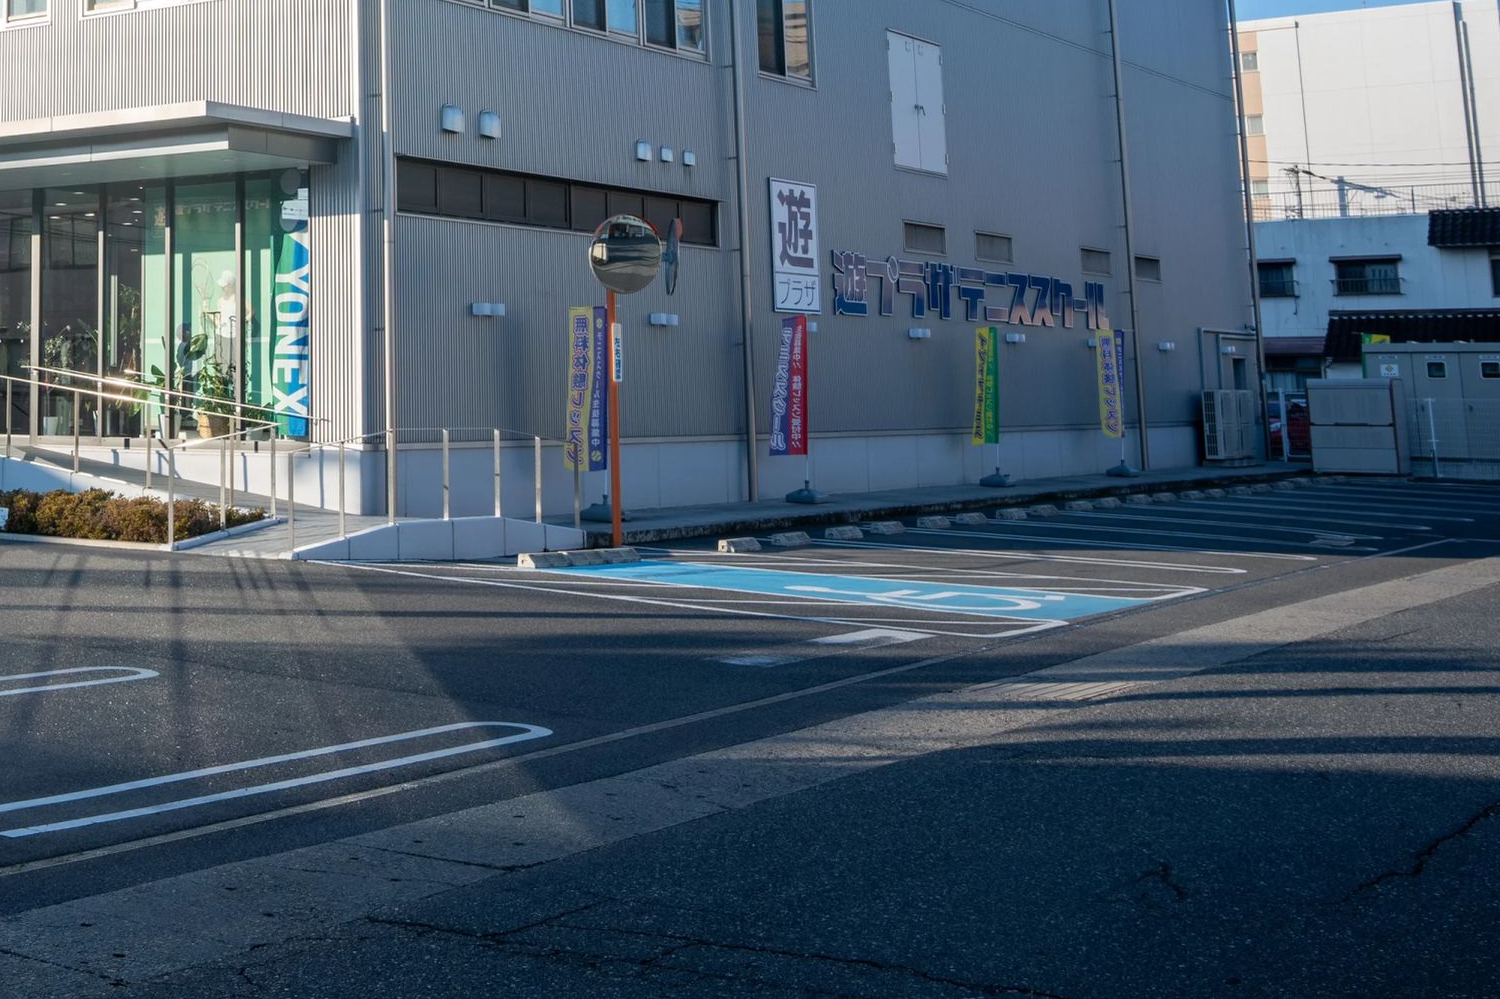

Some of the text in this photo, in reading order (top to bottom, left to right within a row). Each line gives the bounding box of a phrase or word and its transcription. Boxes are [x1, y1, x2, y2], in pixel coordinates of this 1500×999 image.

[777, 188, 815, 269] 遊
[778, 278, 817, 307] プラザ
[832, 249, 1110, 331] 遊プラザテニススクール
[273, 273, 308, 416] YONEX
